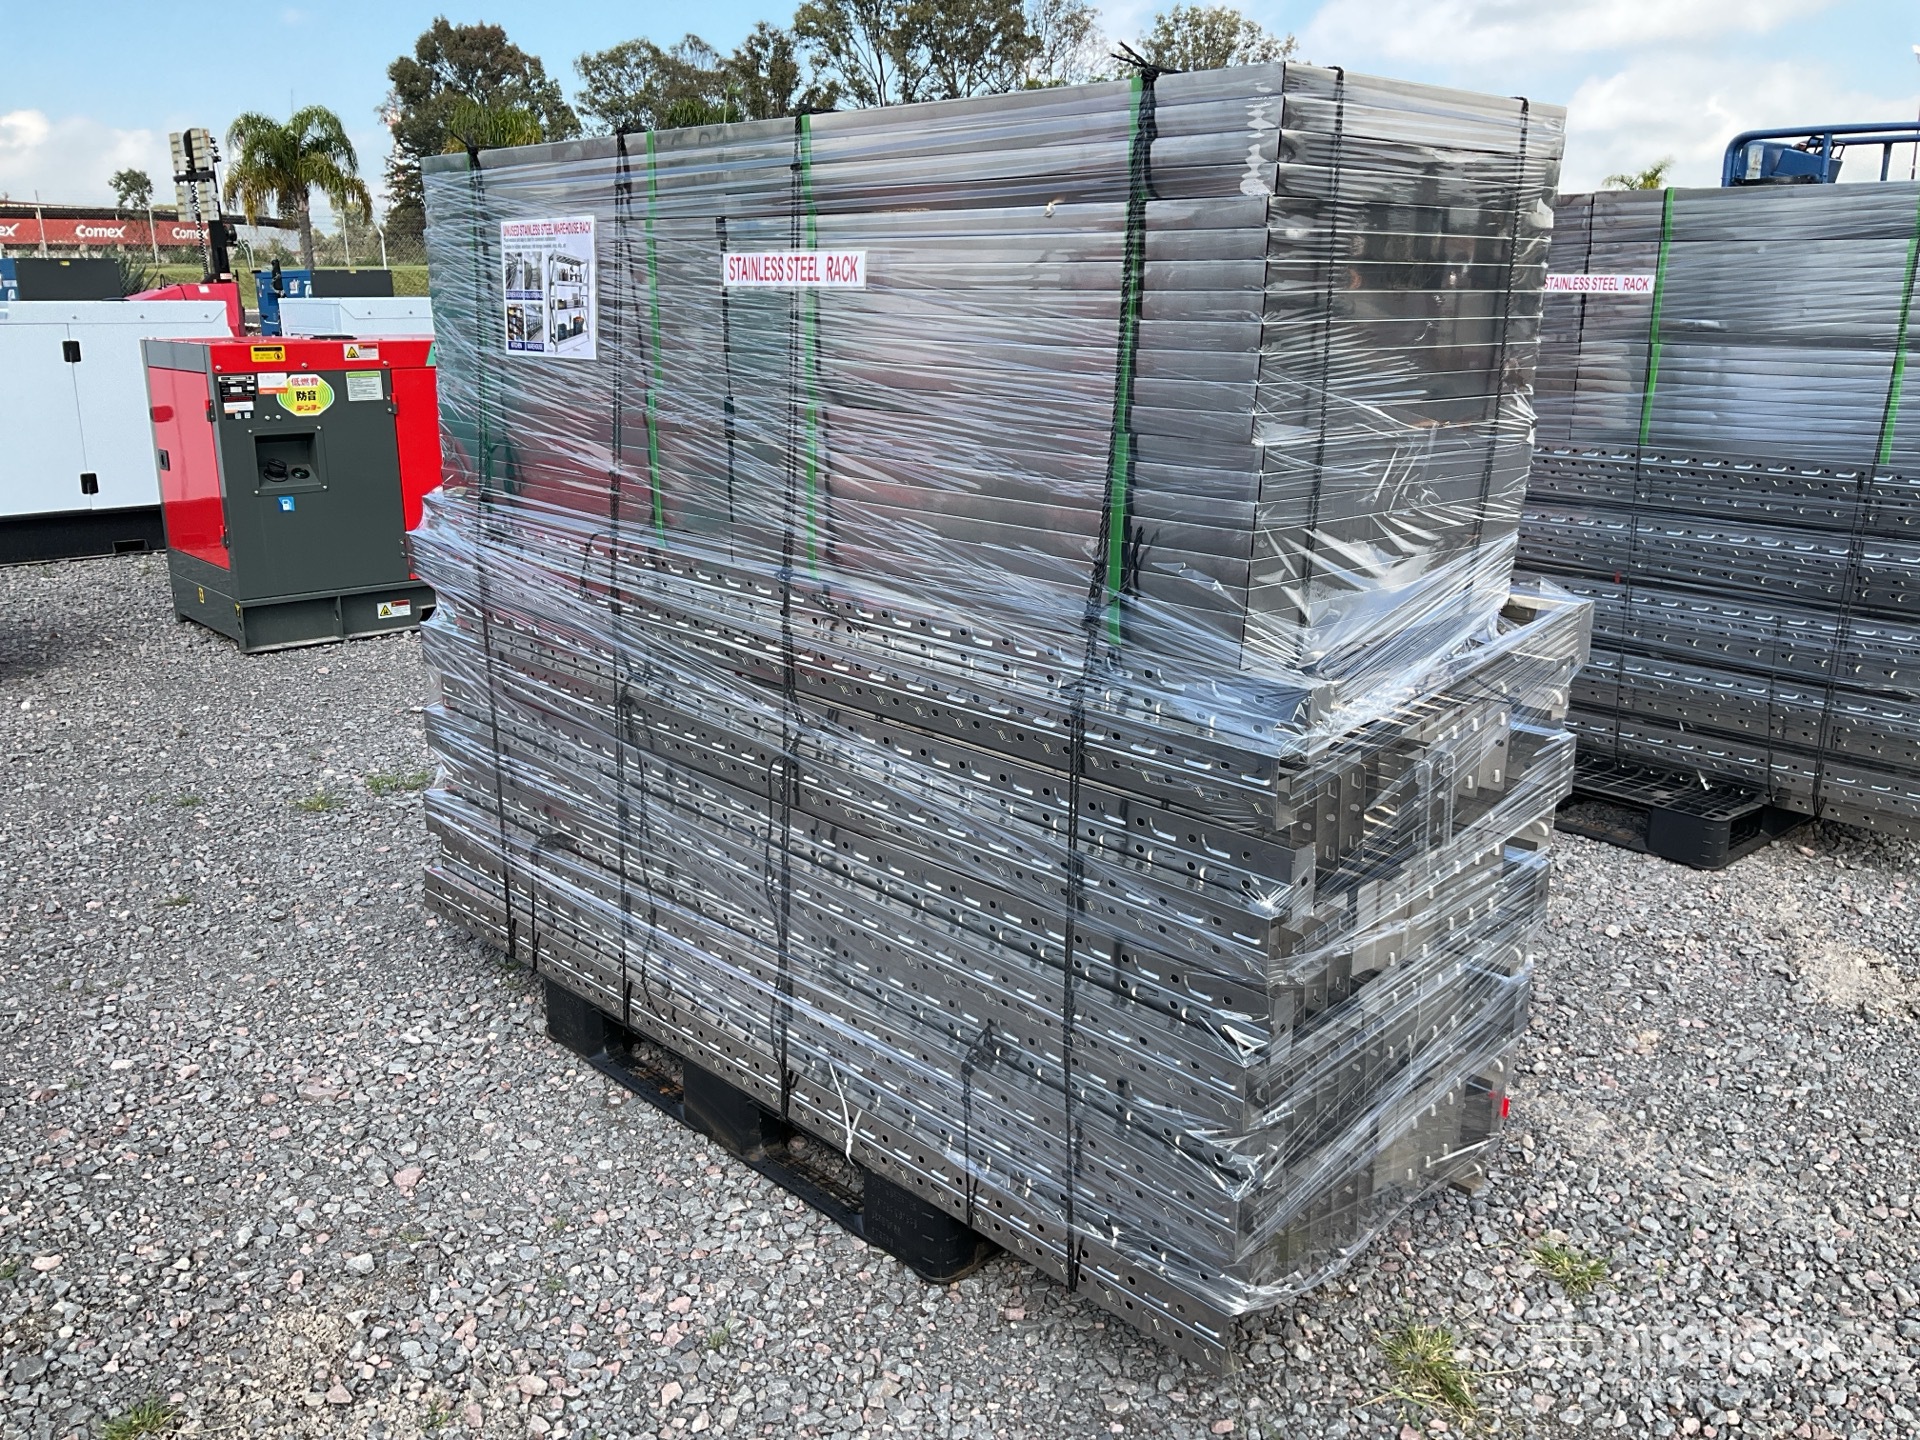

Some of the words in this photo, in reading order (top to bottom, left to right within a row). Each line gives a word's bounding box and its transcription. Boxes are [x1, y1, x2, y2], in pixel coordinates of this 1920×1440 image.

[75, 224, 127, 238] Comex
[520, 224, 541, 237] STAINLESS
[541, 223, 554, 236] STEEL
[554, 222, 580, 235] WAREHOUSE
[580, 221, 592, 234] RACK
[729, 255, 784, 282] STAINLESS
[786, 255, 821, 282] STEEL
[826, 255, 859, 282] RACK
[1544, 276, 1592, 291] STAINLESS
[1592, 276, 1619, 291] STEEL
[1623, 277, 1650, 292] RACK
[296, 390, 316, 401] 防音
